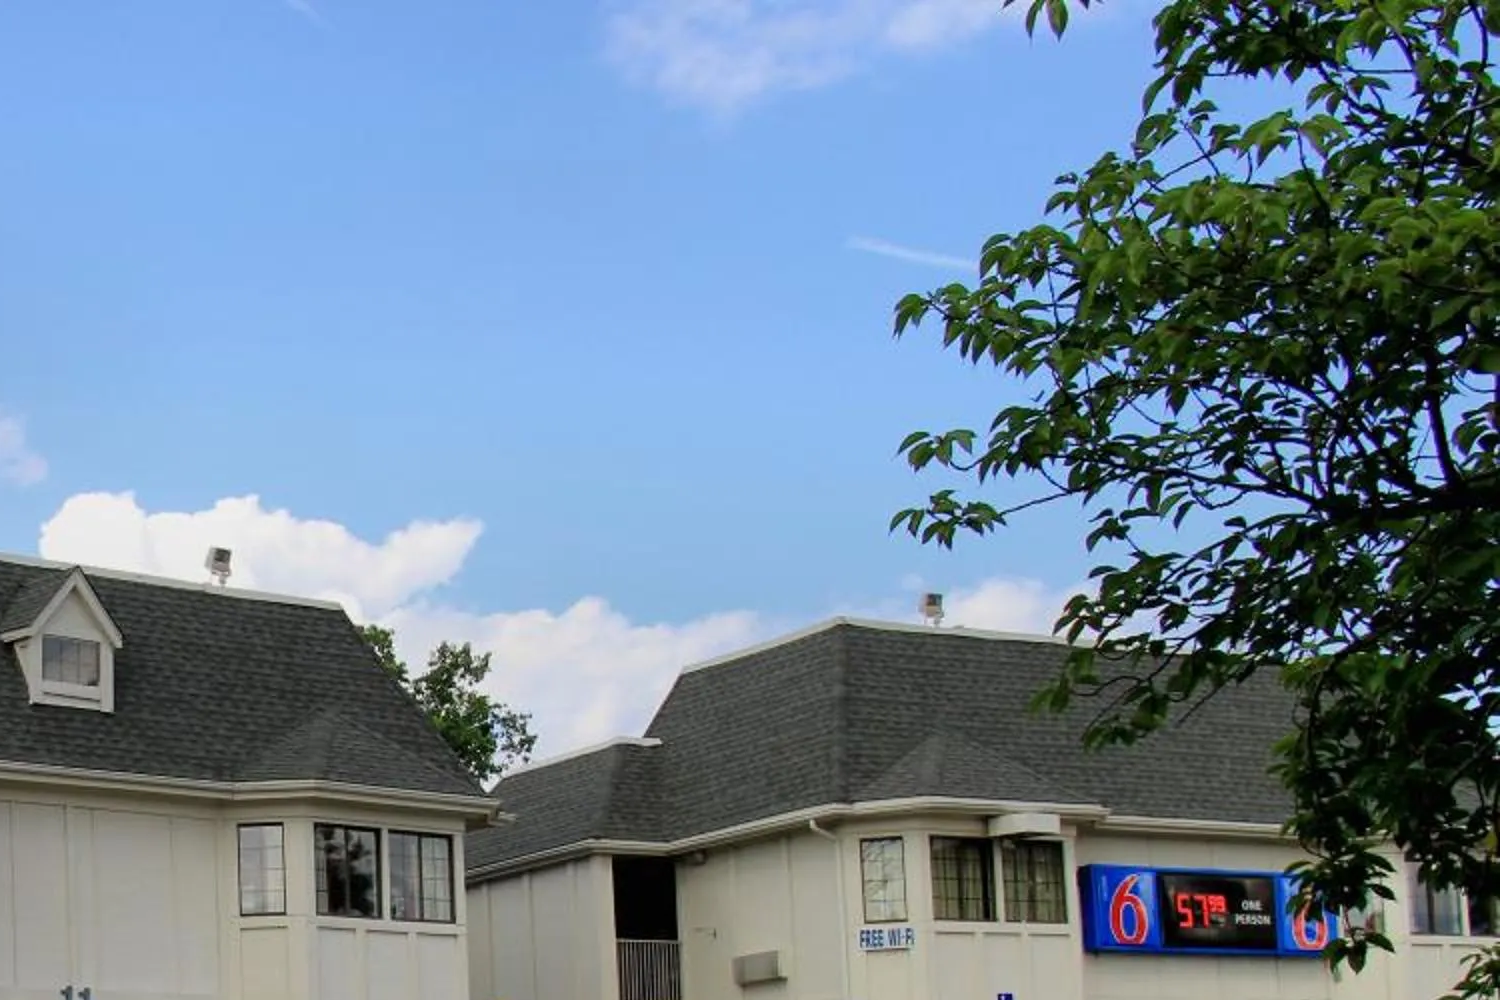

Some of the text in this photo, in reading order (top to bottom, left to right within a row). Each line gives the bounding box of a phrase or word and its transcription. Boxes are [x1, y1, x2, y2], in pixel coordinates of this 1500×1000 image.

[1110, 874, 1148, 944] 6
[1241, 899, 1263, 911] ONE
[1235, 913, 1271, 925] PERSON
[859, 927, 915, 948] FREE WI-FI
